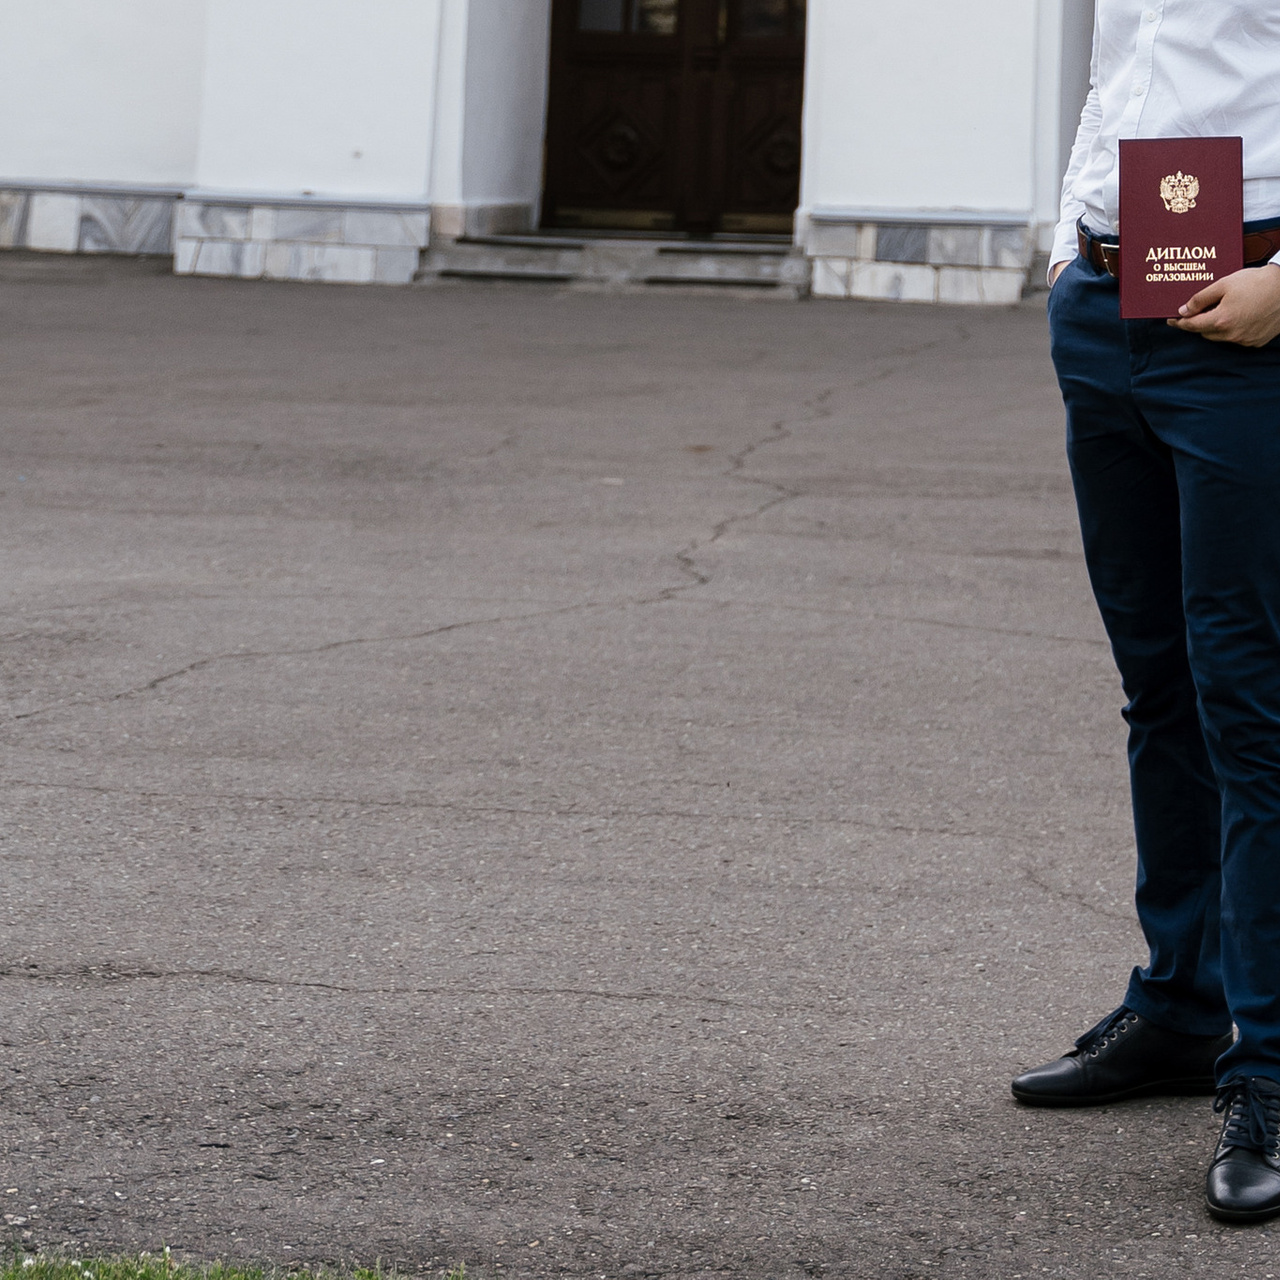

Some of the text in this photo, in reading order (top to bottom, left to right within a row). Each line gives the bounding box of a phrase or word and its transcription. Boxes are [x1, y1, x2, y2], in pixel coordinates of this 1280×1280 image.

[1146, 247, 1217, 262] ДИПЛОМ
[1153, 262, 1206, 272] О ВЫСШЕМ
[1146, 272, 1214, 282] ОБРАЗОВАНИИ
